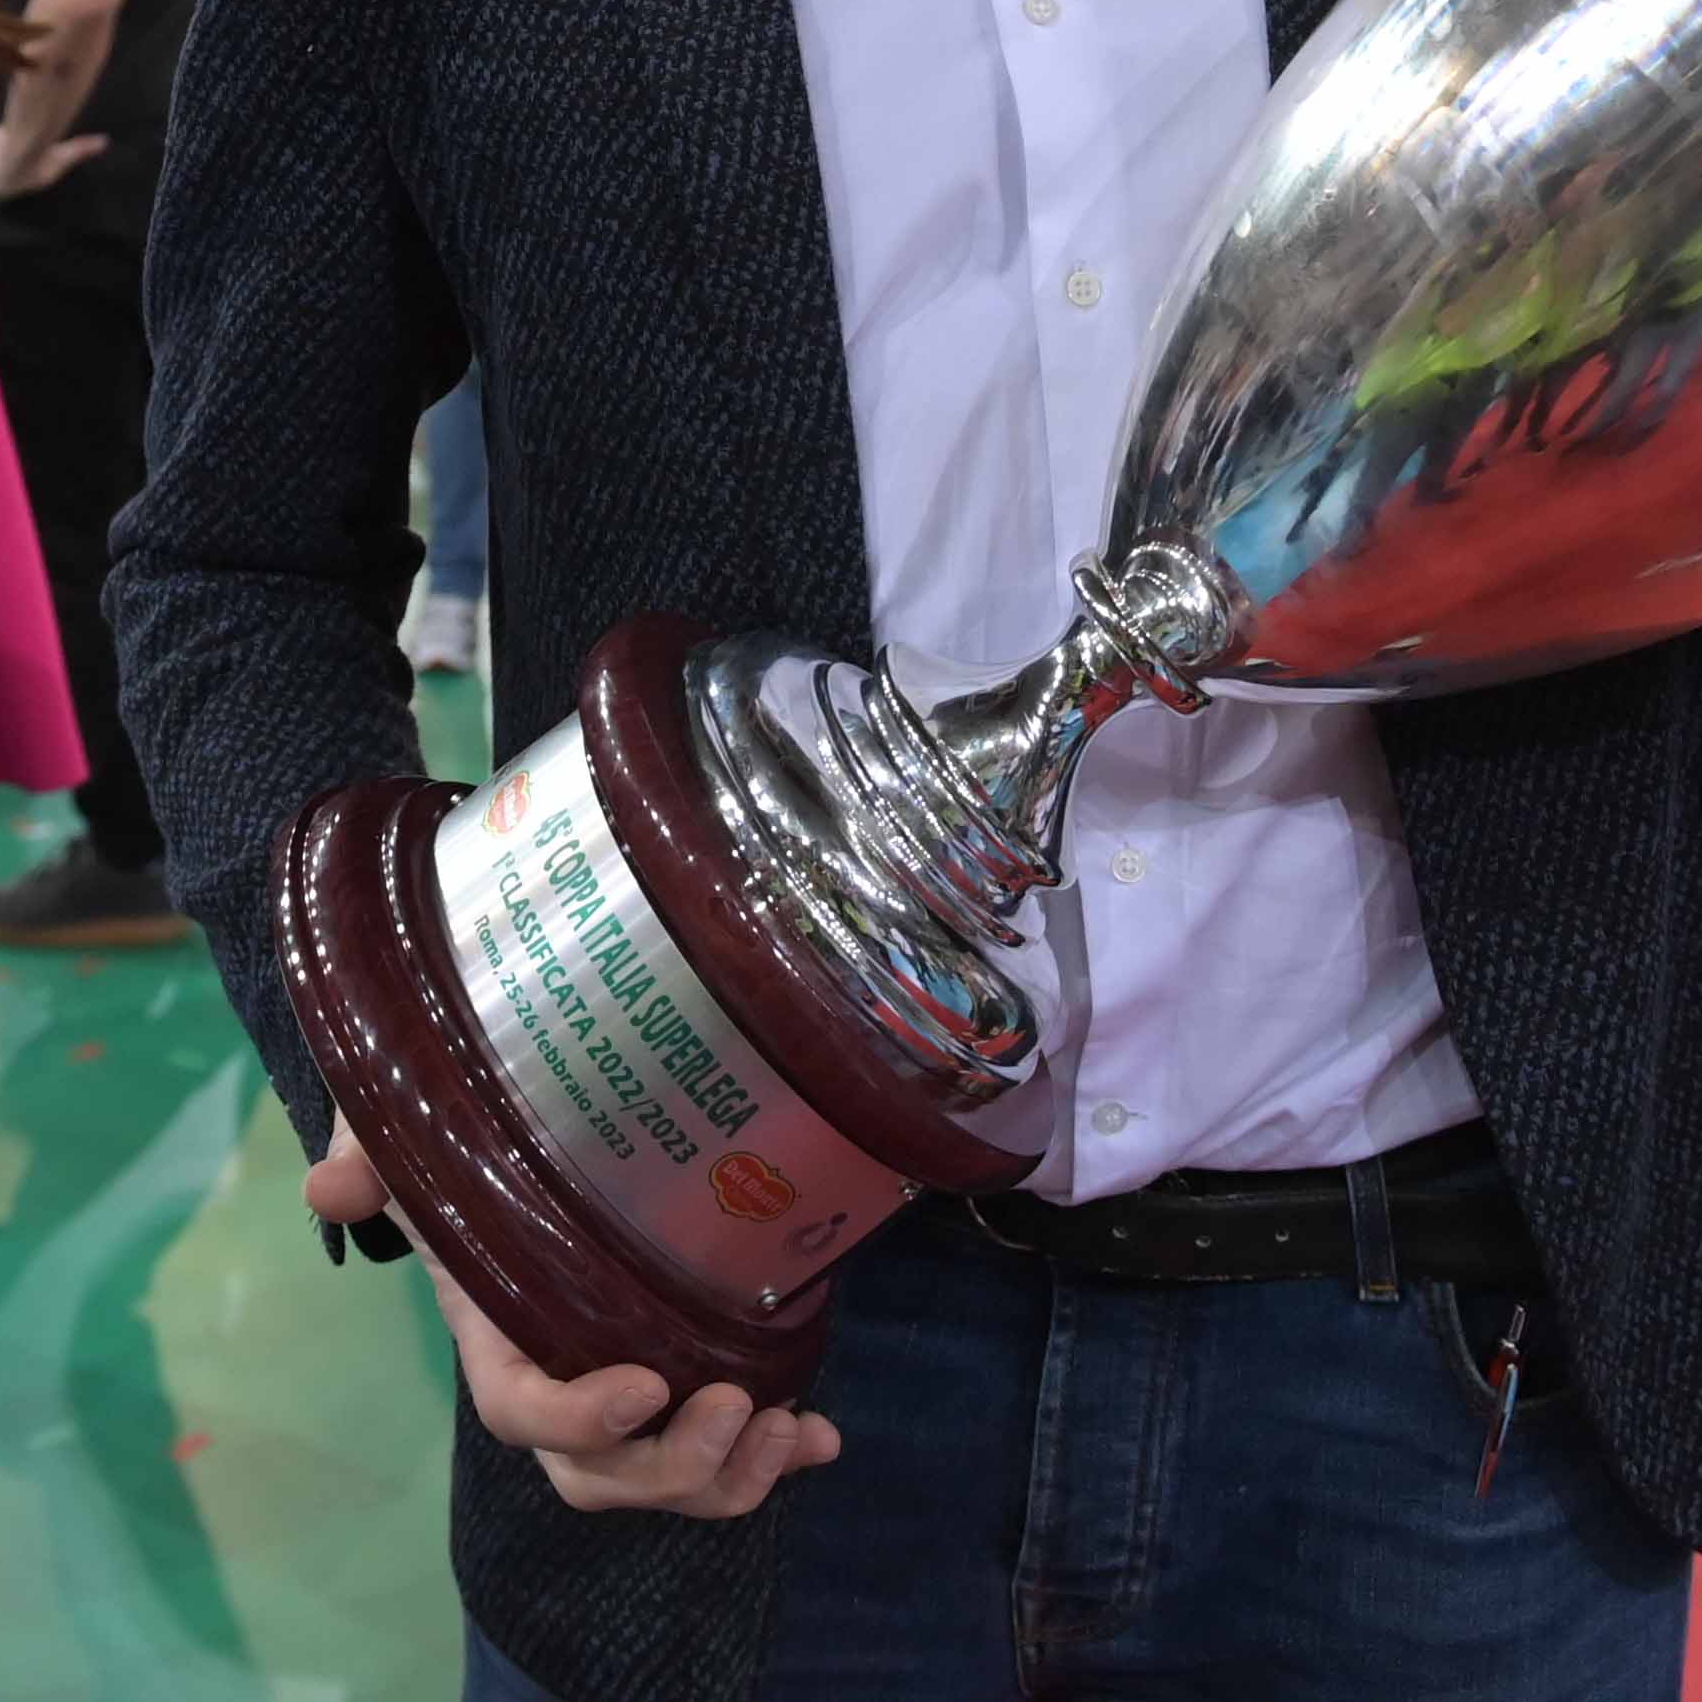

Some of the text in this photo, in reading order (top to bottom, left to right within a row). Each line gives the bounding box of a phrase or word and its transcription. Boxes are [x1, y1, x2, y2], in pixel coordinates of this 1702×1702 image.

[474, 914, 636, 1161] Roma, 25-26 febbraio 2023
[499, 870, 597, 1043] CLASSIFICATA
[585, 1035, 700, 1165] 2022/2023
[544, 839, 607, 932] COPPA
[579, 912, 657, 1014] ITALIA
[628, 994, 760, 1139] SUPERLEGA
